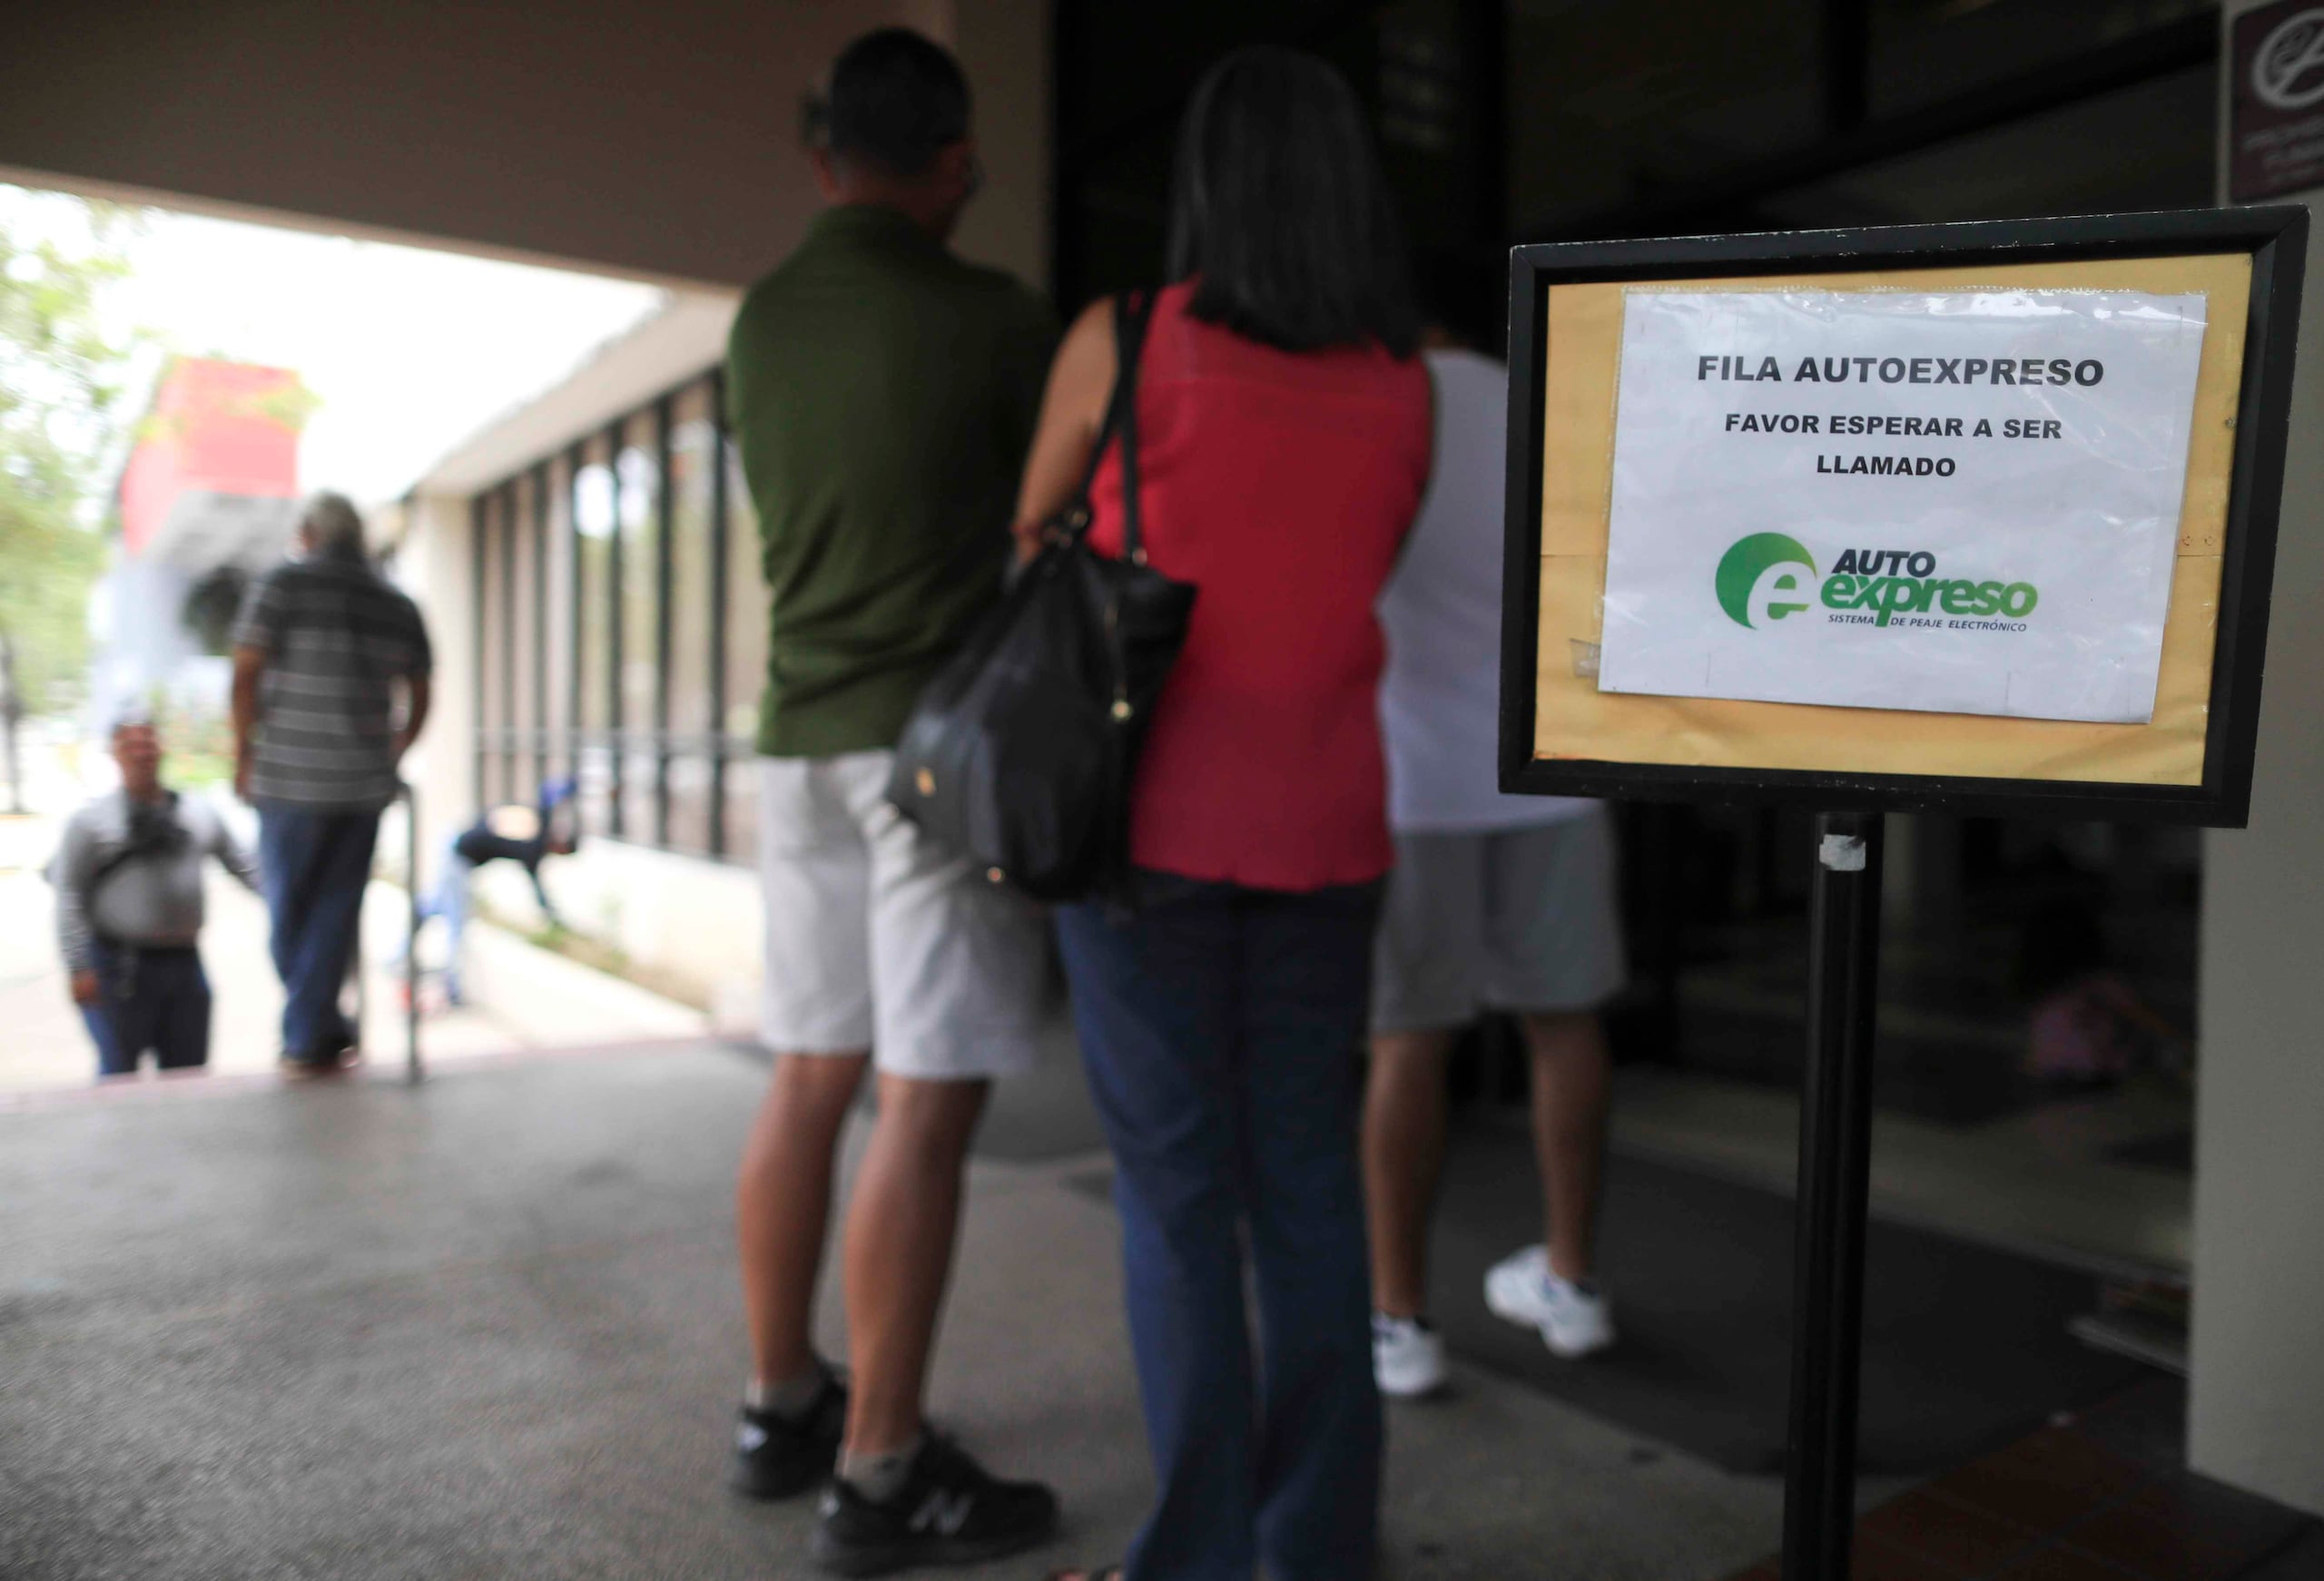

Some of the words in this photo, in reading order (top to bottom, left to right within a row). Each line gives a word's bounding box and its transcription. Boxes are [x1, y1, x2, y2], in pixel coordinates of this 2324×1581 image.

[1698, 355, 1781, 382] FILA
[1794, 357, 2104, 387] AUTOEXPRESO
[1725, 414, 1819, 434] FAVOR
[1828, 416, 1964, 437] ESPERAR
[1972, 418, 1993, 437] A
[2003, 419, 2063, 439] SER
[1817, 455, 1955, 477] LLAMADO
[1831, 549, 1936, 578] AUTO
[1820, 573, 2038, 627] expreso
[1828, 614, 1874, 625] SISTEMA
[1890, 617, 1905, 626] DE
[1909, 618, 1942, 628] PEAJE
[1948, 620, 2027, 632] ELECTRÓNICO
